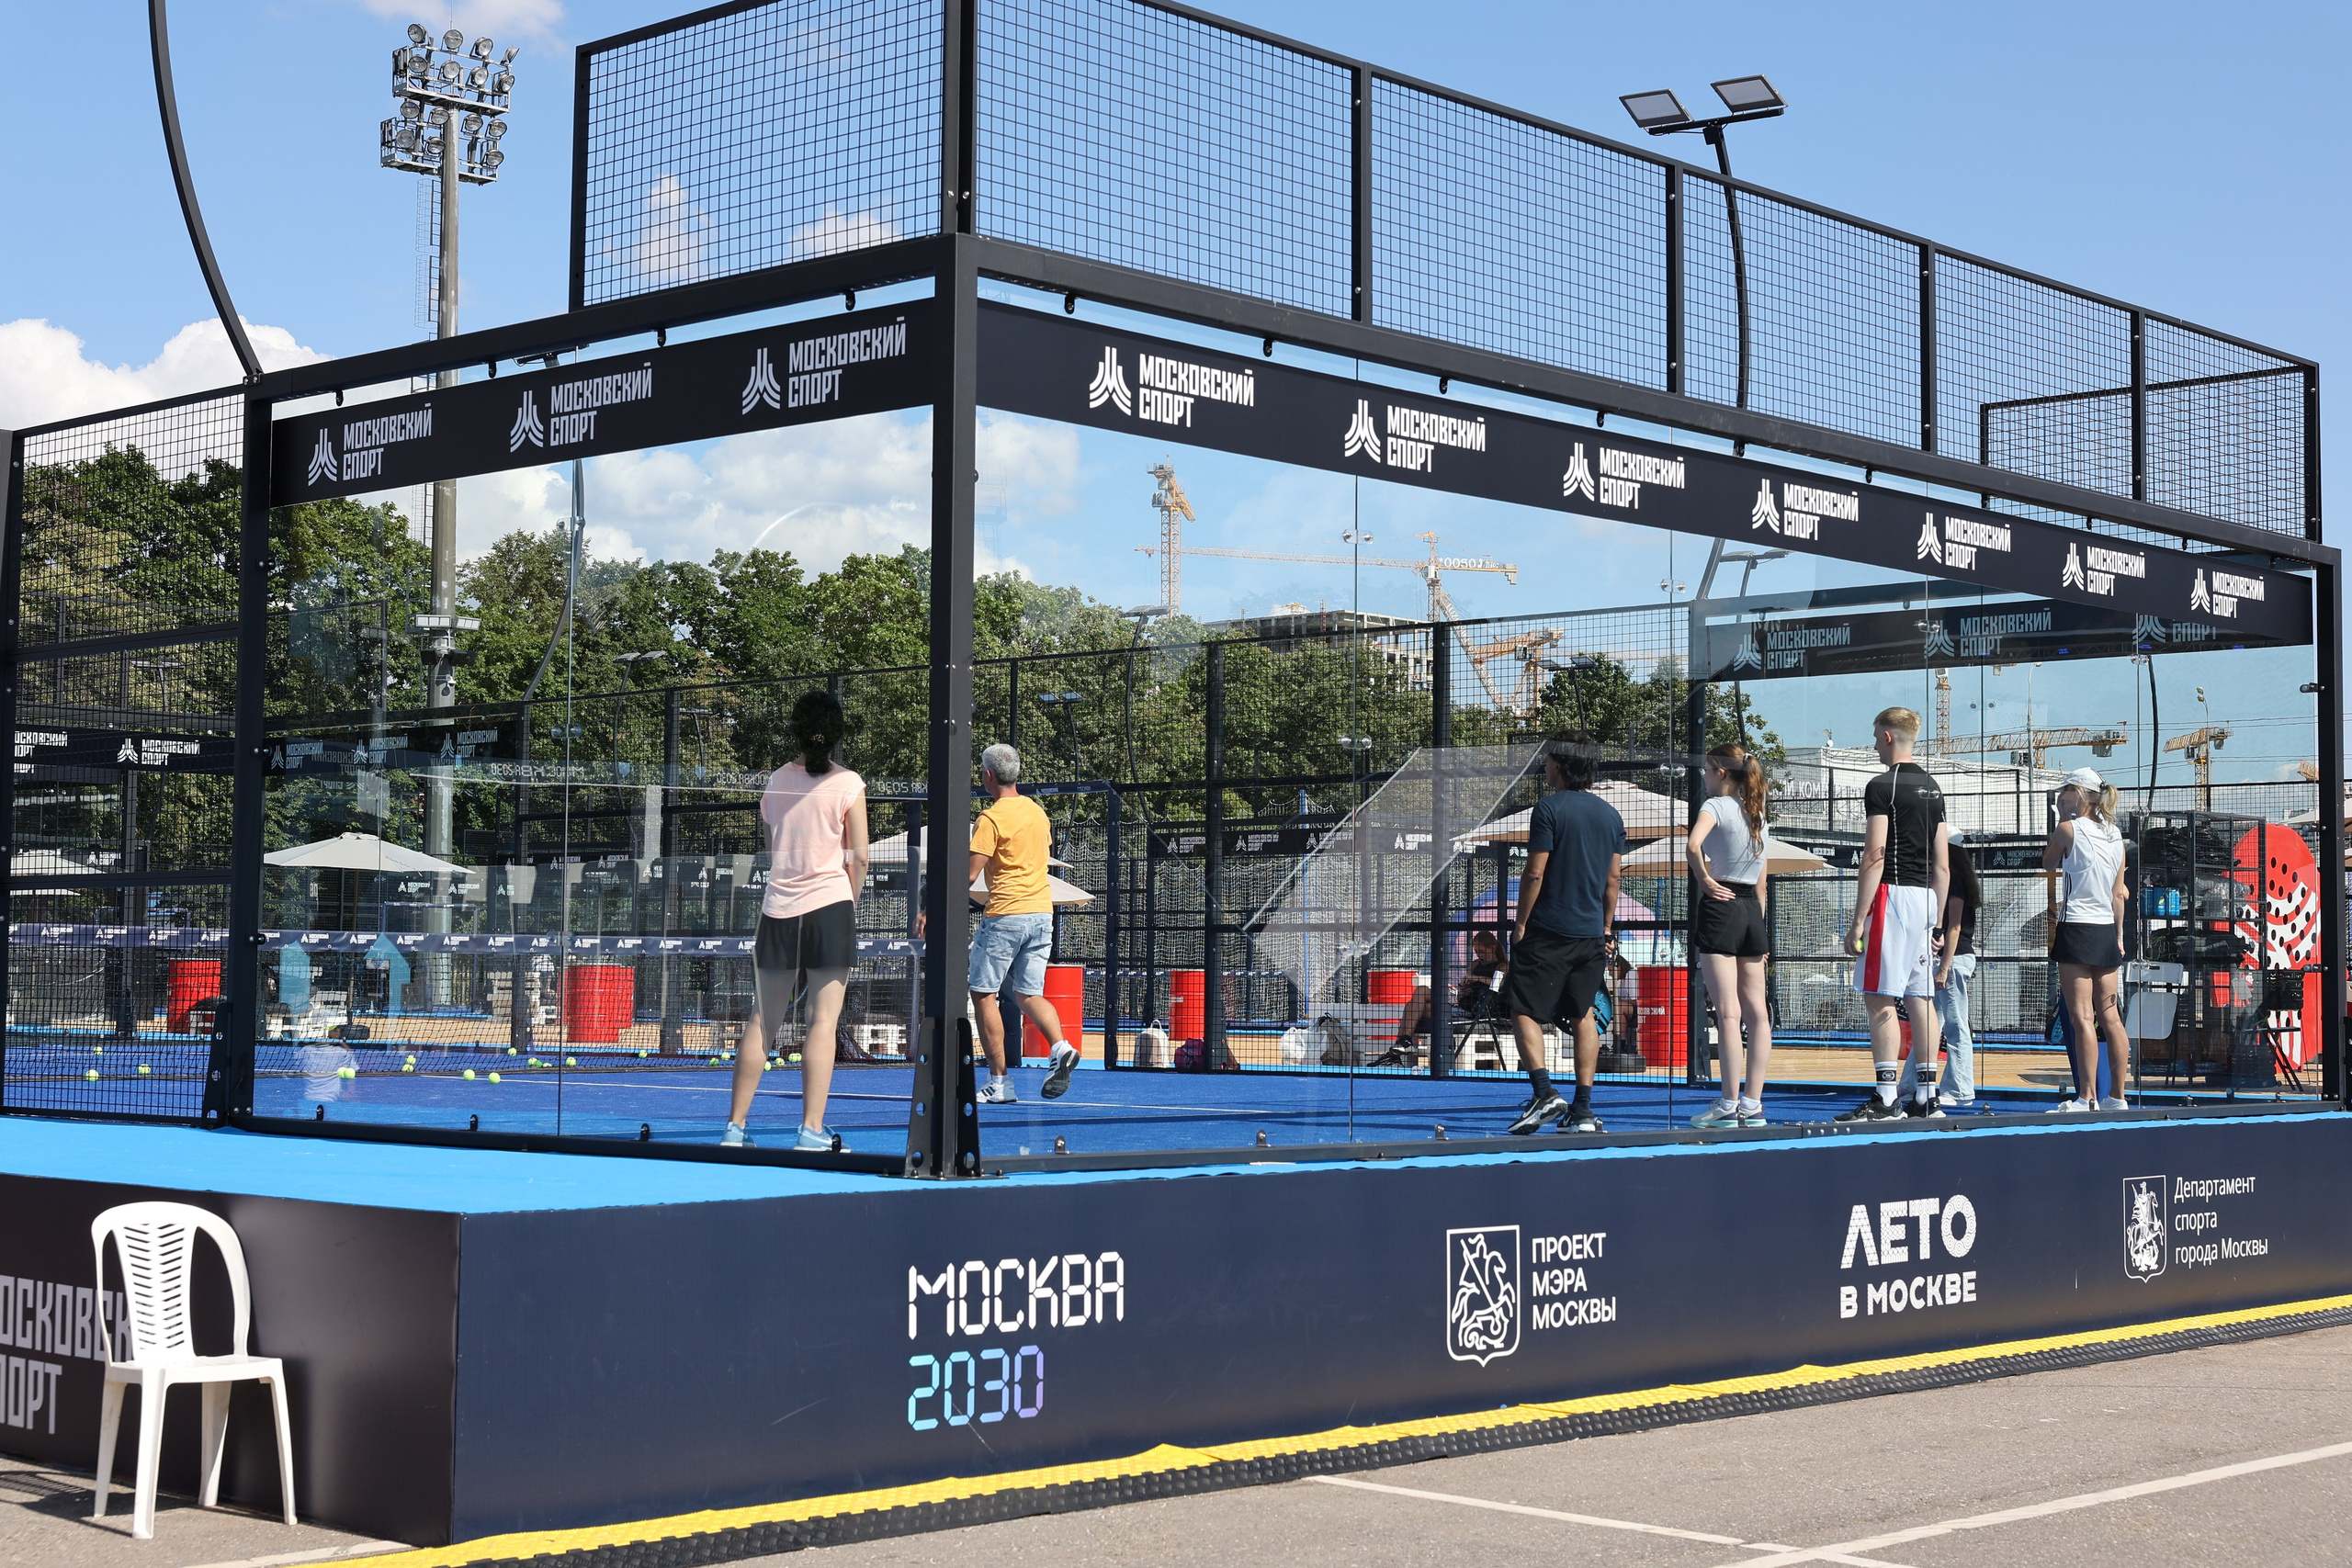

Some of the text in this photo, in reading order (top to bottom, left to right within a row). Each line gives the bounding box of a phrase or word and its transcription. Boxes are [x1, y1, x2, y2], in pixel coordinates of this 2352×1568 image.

[789, 317, 907, 375] МОСКОВСКИЙ
[550, 362, 652, 413] МОСКОВСКИЙ
[787, 369, 843, 409] СПОРТ
[1139, 354, 1255, 407] МОСКОВСКИЙ
[1139, 387, 1194, 428] СПОРТ
[343, 402, 433, 451] МОСКОВСКИЙ
[549, 410, 597, 446] СПОРТ
[1387, 405, 1487, 452] МОСКОВСКИЙ
[343, 447, 384, 481] СПОРТ
[1387, 432, 1433, 473] СПОРТ
[1600, 446, 1685, 490] МОСКОВСКИЙ
[1600, 474, 1640, 510] СПОРТ
[1783, 484, 1860, 522] МОСКОВСКИЙ
[1783, 509, 1821, 540] СПОРТ
[1945, 519, 2012, 553] МОСКОВСКИЙ
[1945, 540, 1977, 571] СПОРТ
[2087, 549, 2145, 581] МОСКОВСКИЙ
[2087, 568, 2115, 597] СПОРТ
[2212, 571, 2266, 602] МОСКОВСКИЙ
[2212, 590, 2238, 619] СПОРТ
[1767, 623, 1850, 650] МОСКОВСКИЙ
[1960, 608, 2052, 636] МОСКОВСКИЙ
[1767, 649, 1805, 670] СПОРТ
[1960, 636, 2003, 658] СПОРТ
[15, 731, 68, 747] ОСКОВСКИЙ
[2174, 1175, 2256, 1204] Департамент
[1840, 1194, 1977, 1269] ЛЕТО
[2174, 1211, 2218, 1233] спорта
[1532, 1233, 1606, 1263] ПРОЕКТ
[2175, 1238, 2268, 1269] города Москвы
[909, 1251, 1125, 1339] МОСКВА
[1532, 1272, 1588, 1297] МЭРА
[1840, 1270, 1977, 1319] В МОСКВЕ
[1532, 1296, 1617, 1330] МОСКВЫ
[0, 1354, 62, 1434] ОРТ
[908, 1345, 1045, 1430] 2030
